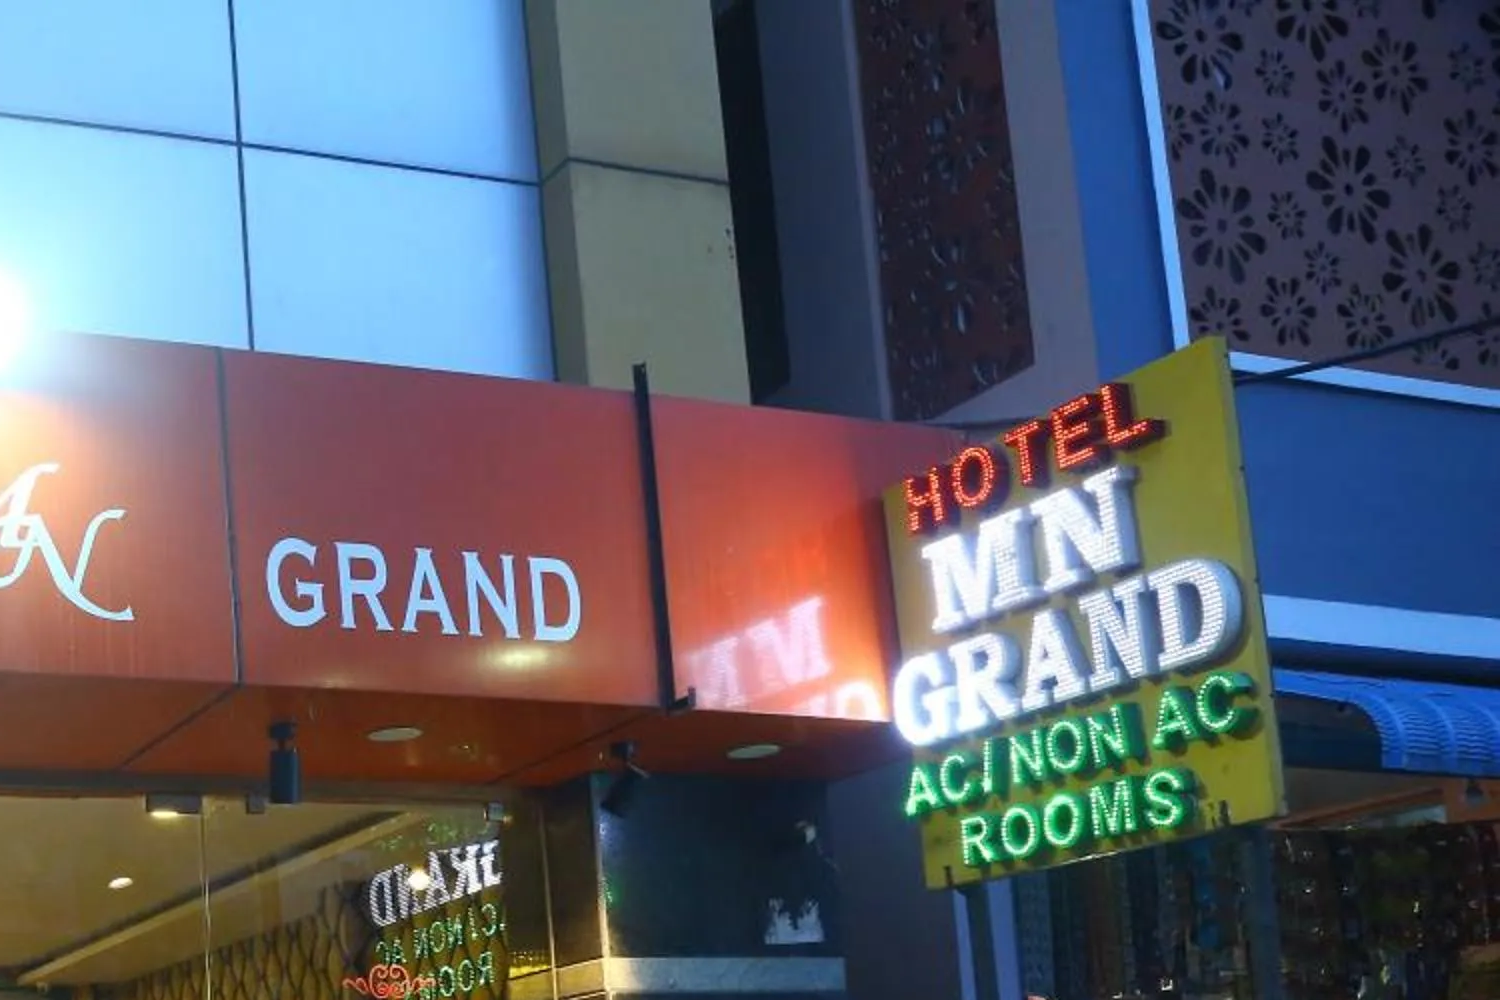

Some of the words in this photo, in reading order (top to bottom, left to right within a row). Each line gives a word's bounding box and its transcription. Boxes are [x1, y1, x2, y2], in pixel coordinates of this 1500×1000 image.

[905, 381, 1150, 532] HOTEL
[266, 537, 582, 642] GRAND
[921, 466, 1140, 634] MN
[894, 557, 1242, 746] GRAND
[1152, 674, 1242, 750] AC
[959, 769, 1186, 865] ROOMS
